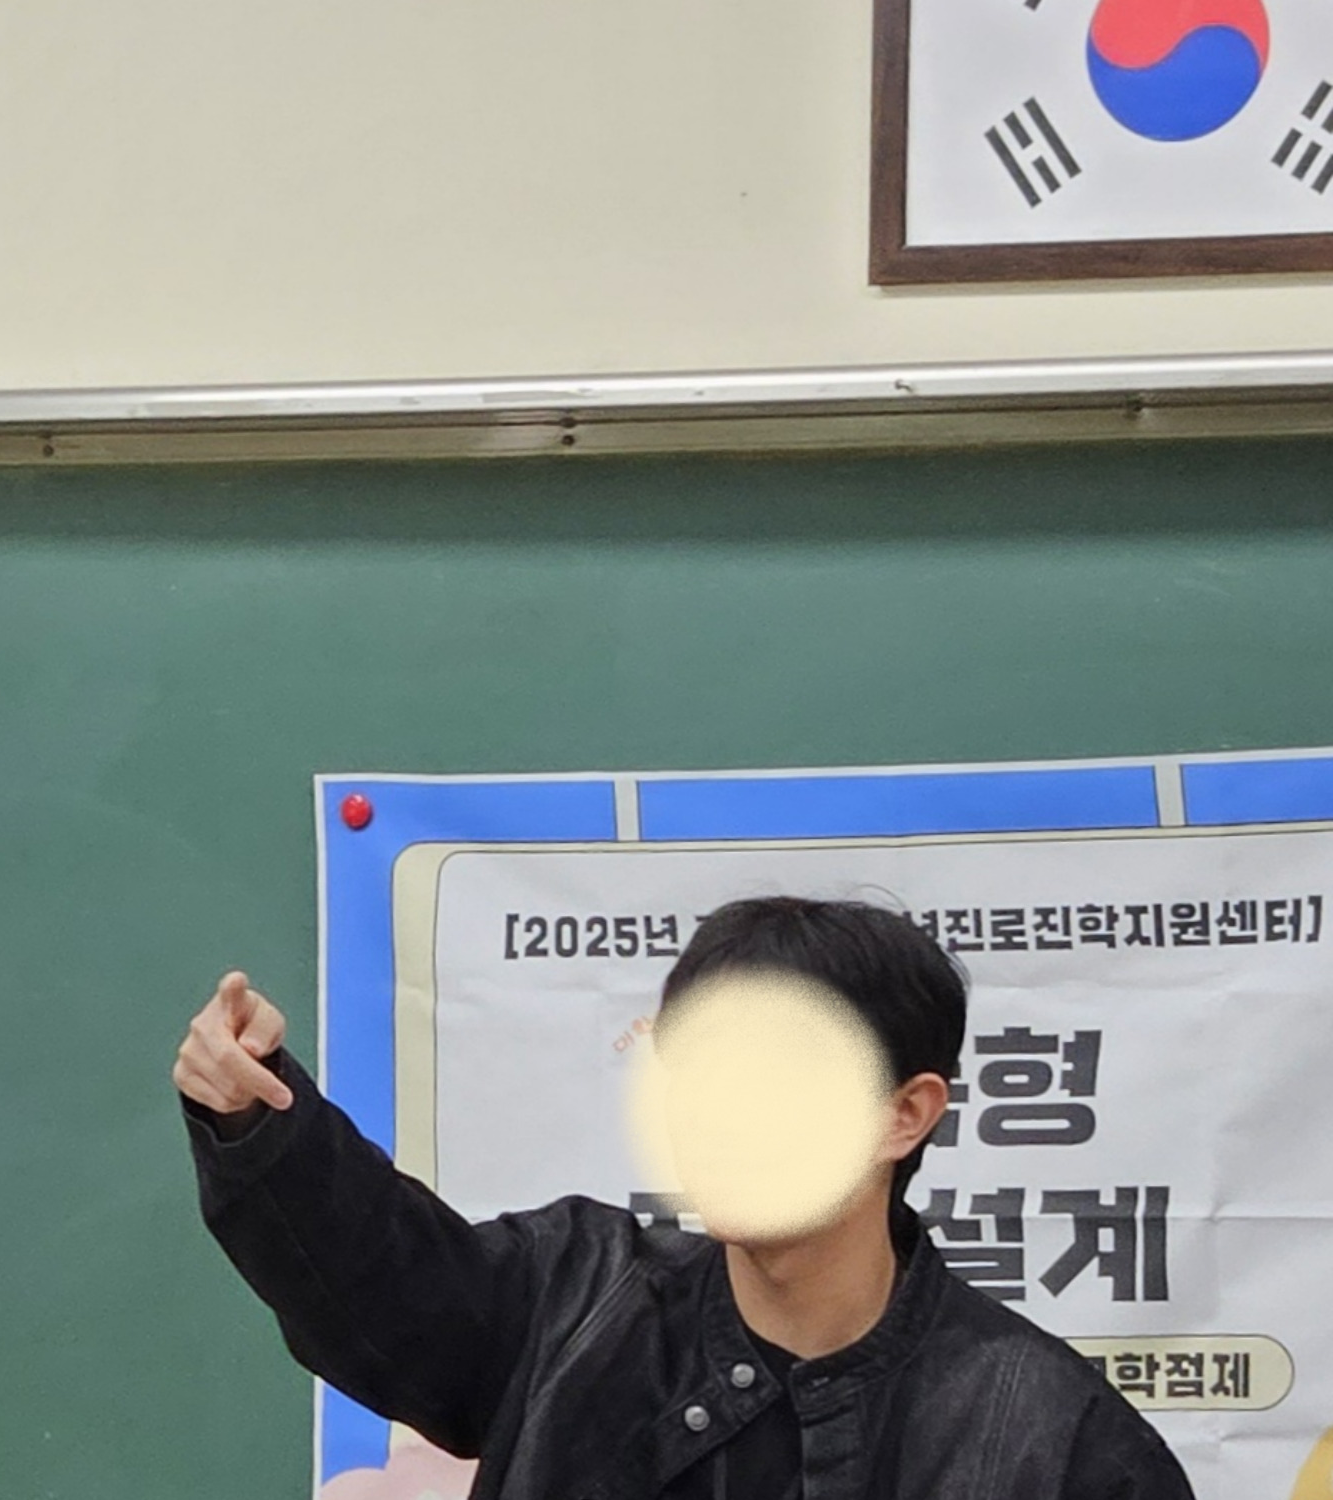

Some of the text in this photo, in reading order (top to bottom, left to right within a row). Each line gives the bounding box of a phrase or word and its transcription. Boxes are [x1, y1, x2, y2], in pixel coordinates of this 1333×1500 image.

[504, 913, 680, 960] [2025년
[934, 1026, 1102, 1147] 형
[920, 1186, 1171, 1302] 설계
[1085, 1351, 1251, 1399] 학점제
